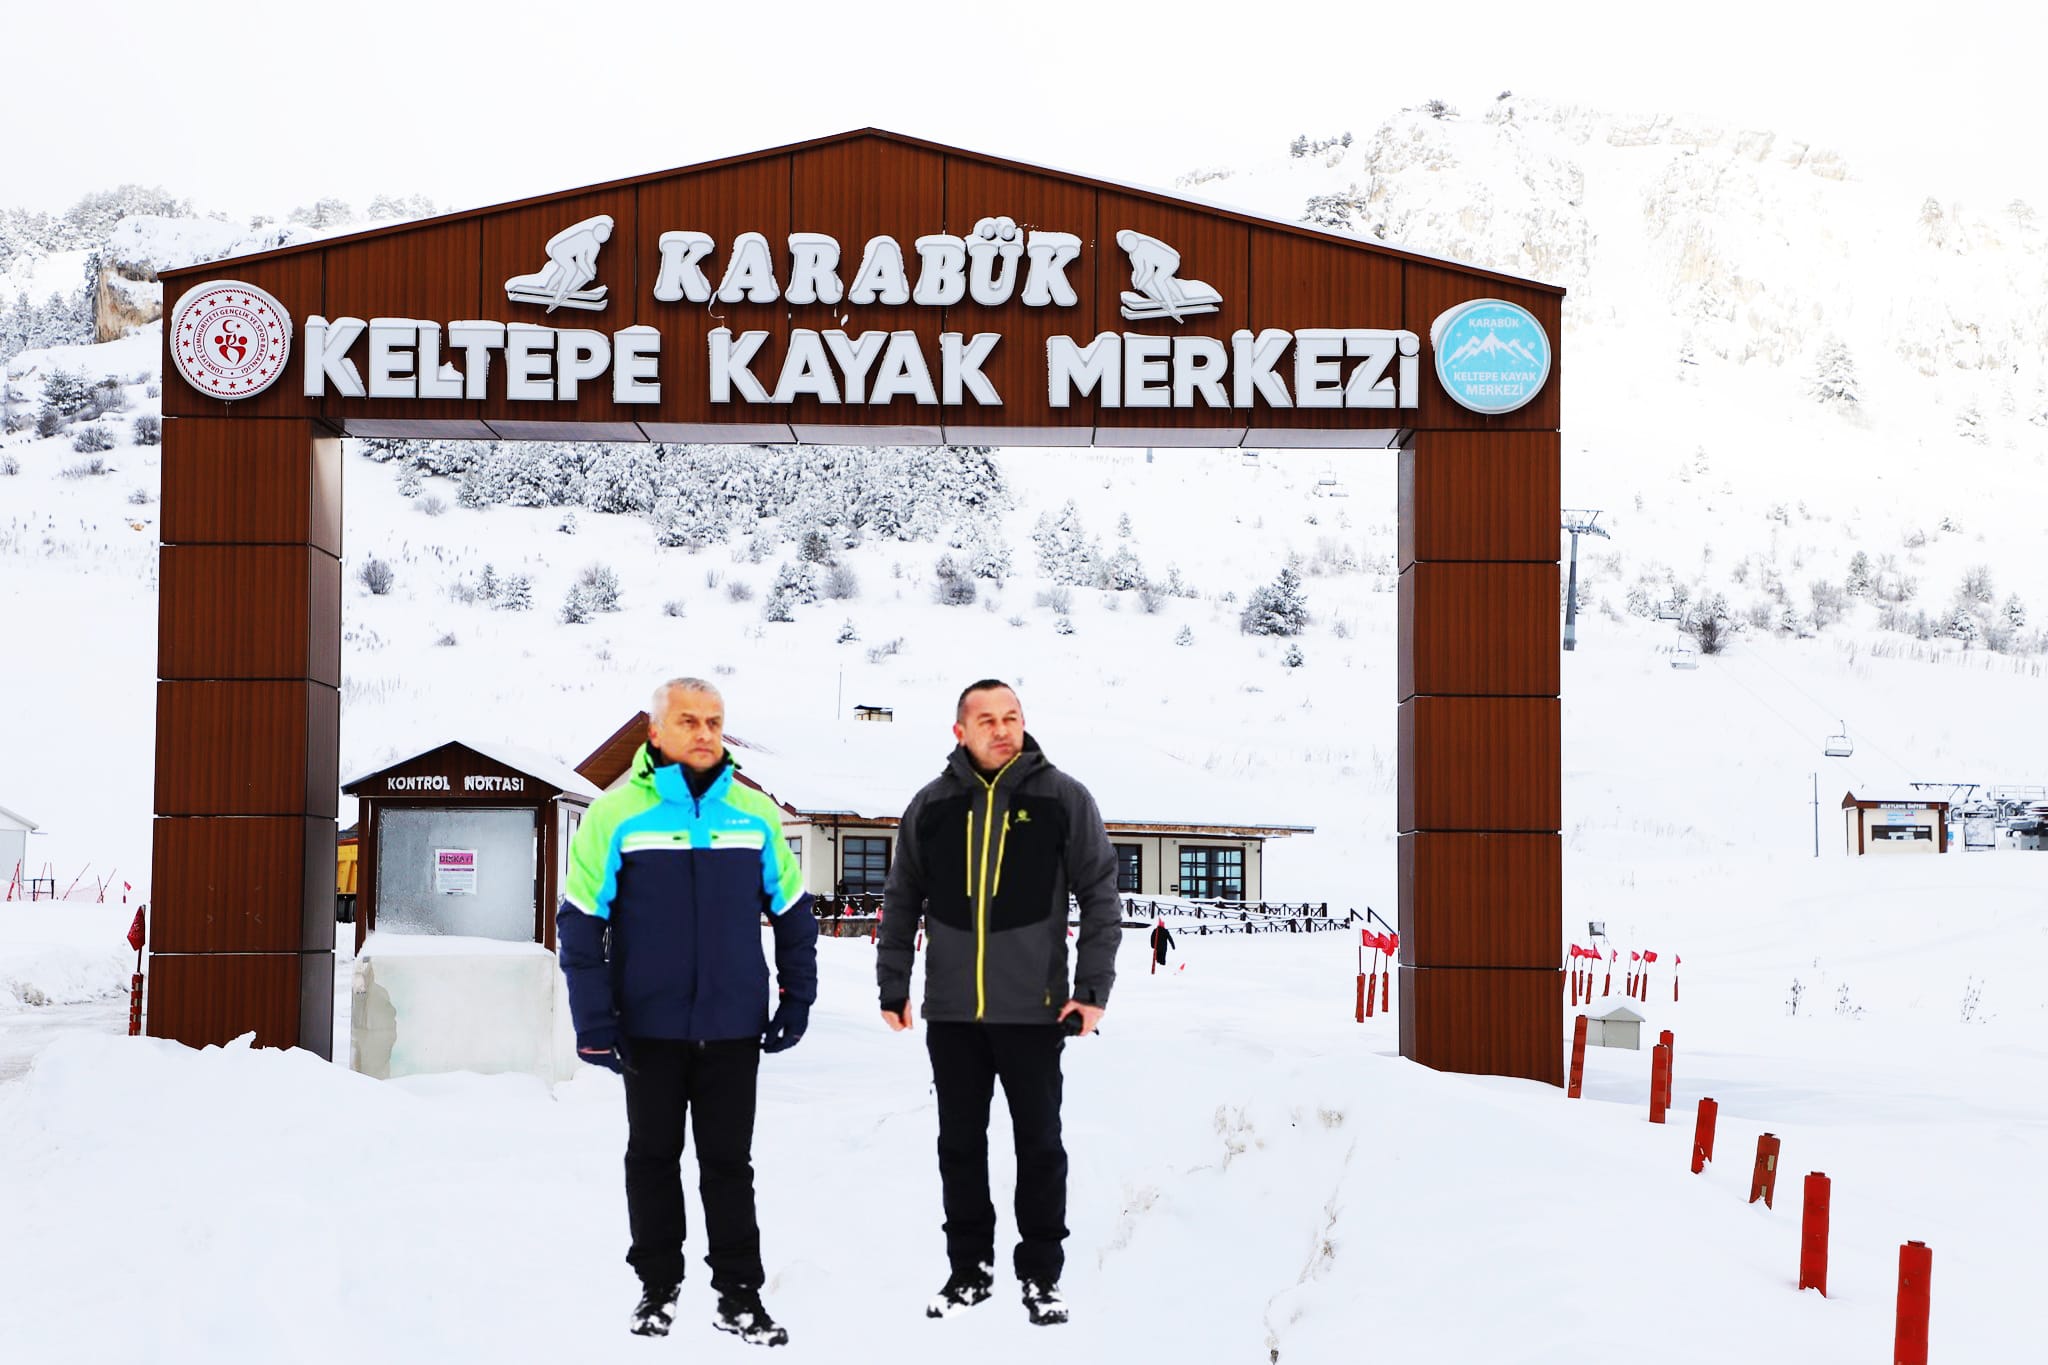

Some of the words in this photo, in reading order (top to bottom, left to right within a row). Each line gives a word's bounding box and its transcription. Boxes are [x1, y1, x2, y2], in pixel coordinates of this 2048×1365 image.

[653, 216, 1082, 307] KARABÜK
[249, 316, 258, 327] VE
[1468, 317, 1519, 328] KARABÜK
[304, 315, 661, 404] KELTEPE
[708, 326, 1003, 405] KAYAK
[1046, 328, 1420, 410] MERKEZİ
[1454, 371, 1498, 382] KELTEPE
[1500, 371, 1537, 382] KAYAK
[1466, 382, 1523, 396] MERKEZİ
[387, 775, 450, 791] KONTROL
[464, 775, 524, 791] NOKTASI
